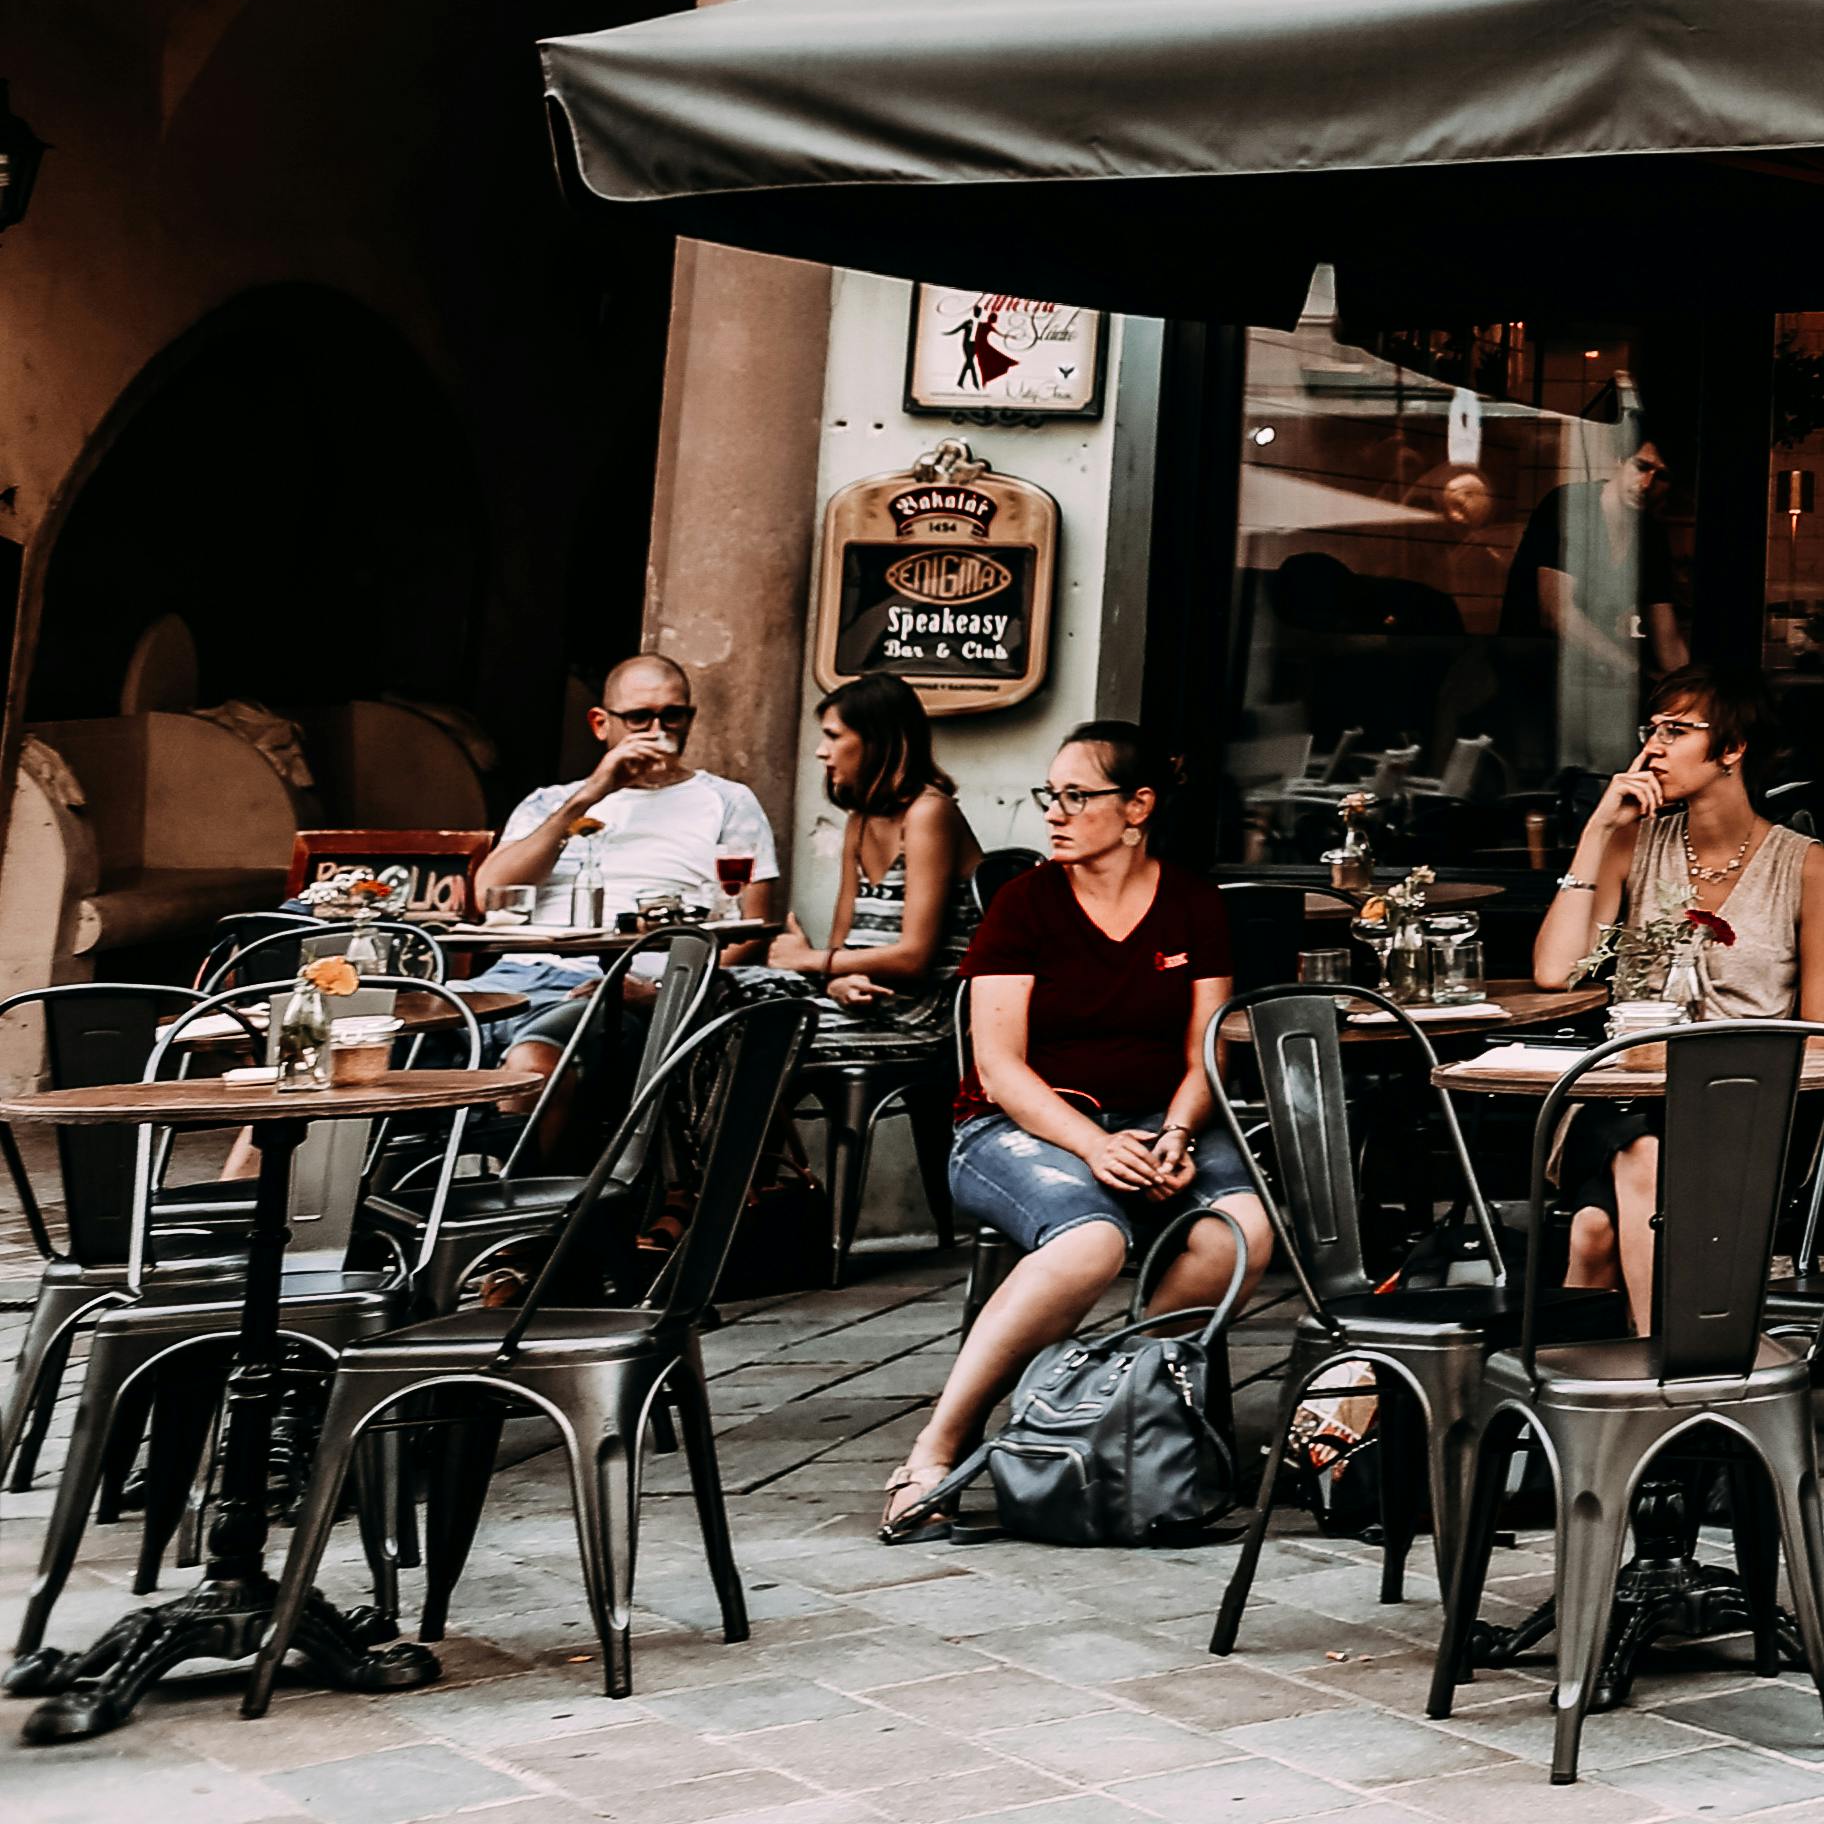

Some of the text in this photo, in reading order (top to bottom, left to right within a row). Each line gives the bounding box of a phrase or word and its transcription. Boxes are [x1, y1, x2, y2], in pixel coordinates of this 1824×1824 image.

[887, 606, 1008, 641] Speakeasy
[883, 639, 1009, 660] Bar & Club
